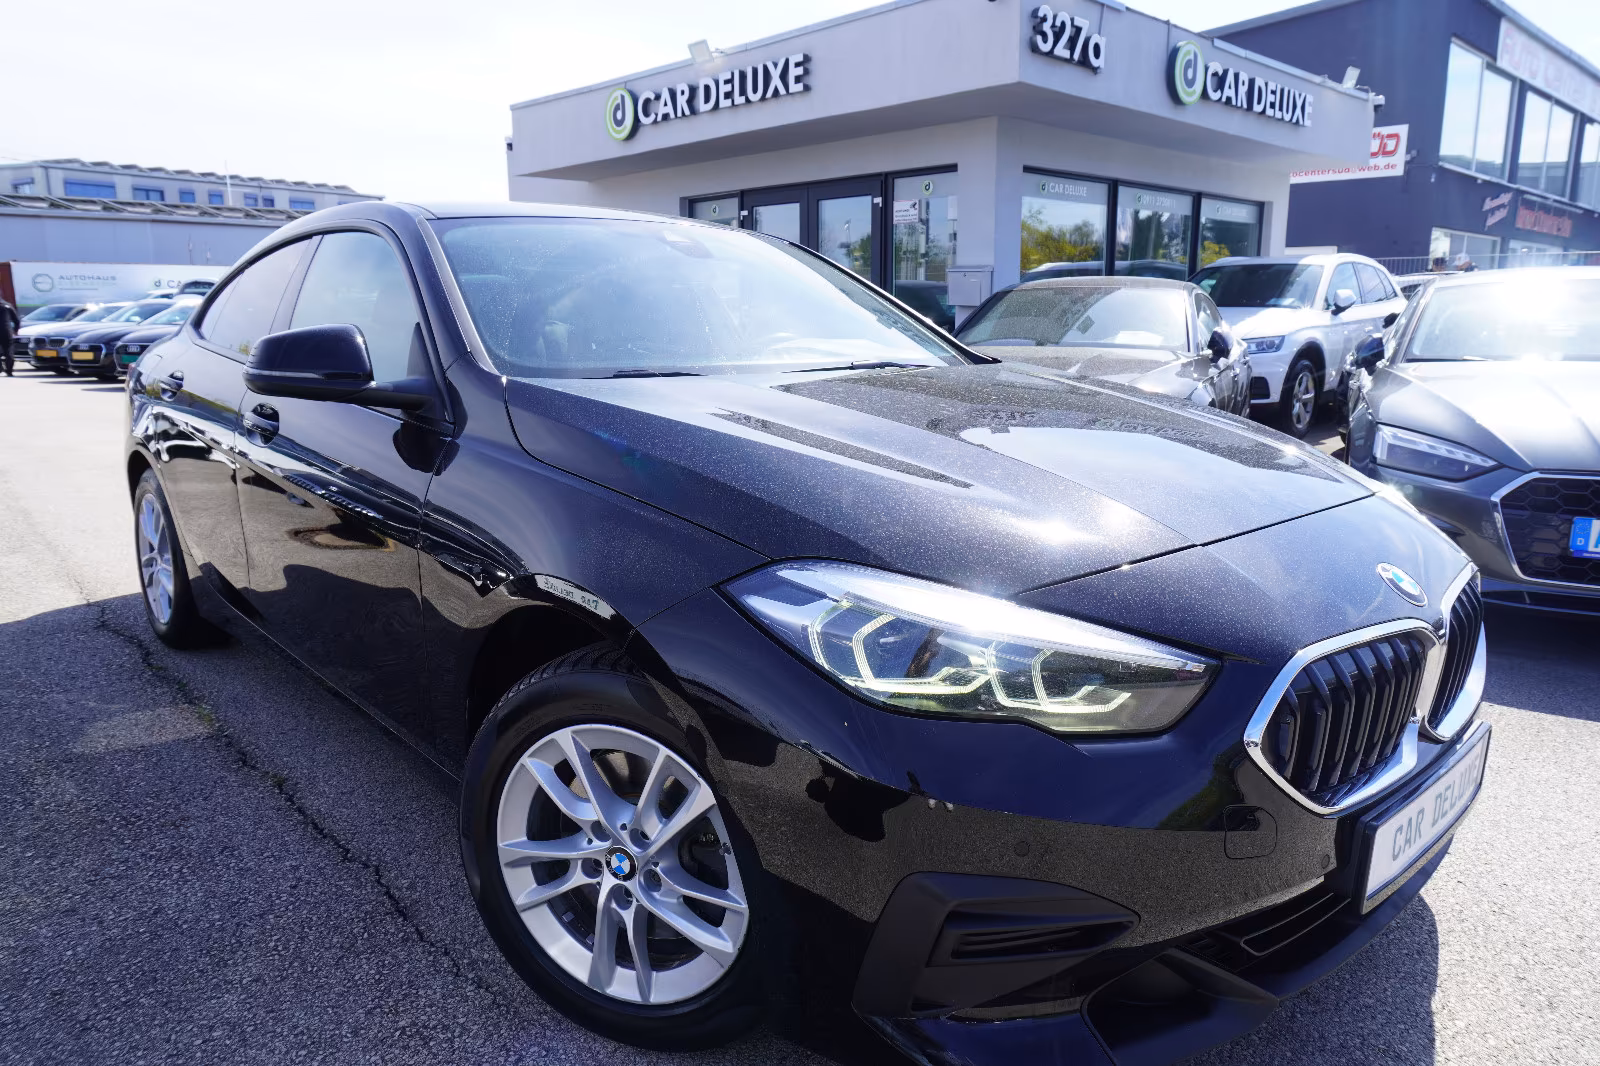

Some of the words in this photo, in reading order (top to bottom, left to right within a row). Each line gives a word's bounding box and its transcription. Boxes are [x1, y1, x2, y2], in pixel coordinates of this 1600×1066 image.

[1035, 4, 1106, 69] 327a
[637, 82, 691, 125] CAR
[699, 52, 805, 113] DELUXE
[1206, 62, 1248, 109] CAR
[1253, 77, 1313, 127] DELUXE
[1370, 131, 1400, 158] ÜD
[1050, 183, 1063, 194] CAR
[1064, 184, 1088, 197] DELUXE
[58, 274, 117, 282] AUTOHAUS
[167, 279, 182, 289] CA
[1391, 806, 1425, 862] CAR
[1431, 751, 1480, 828] DELUXE
